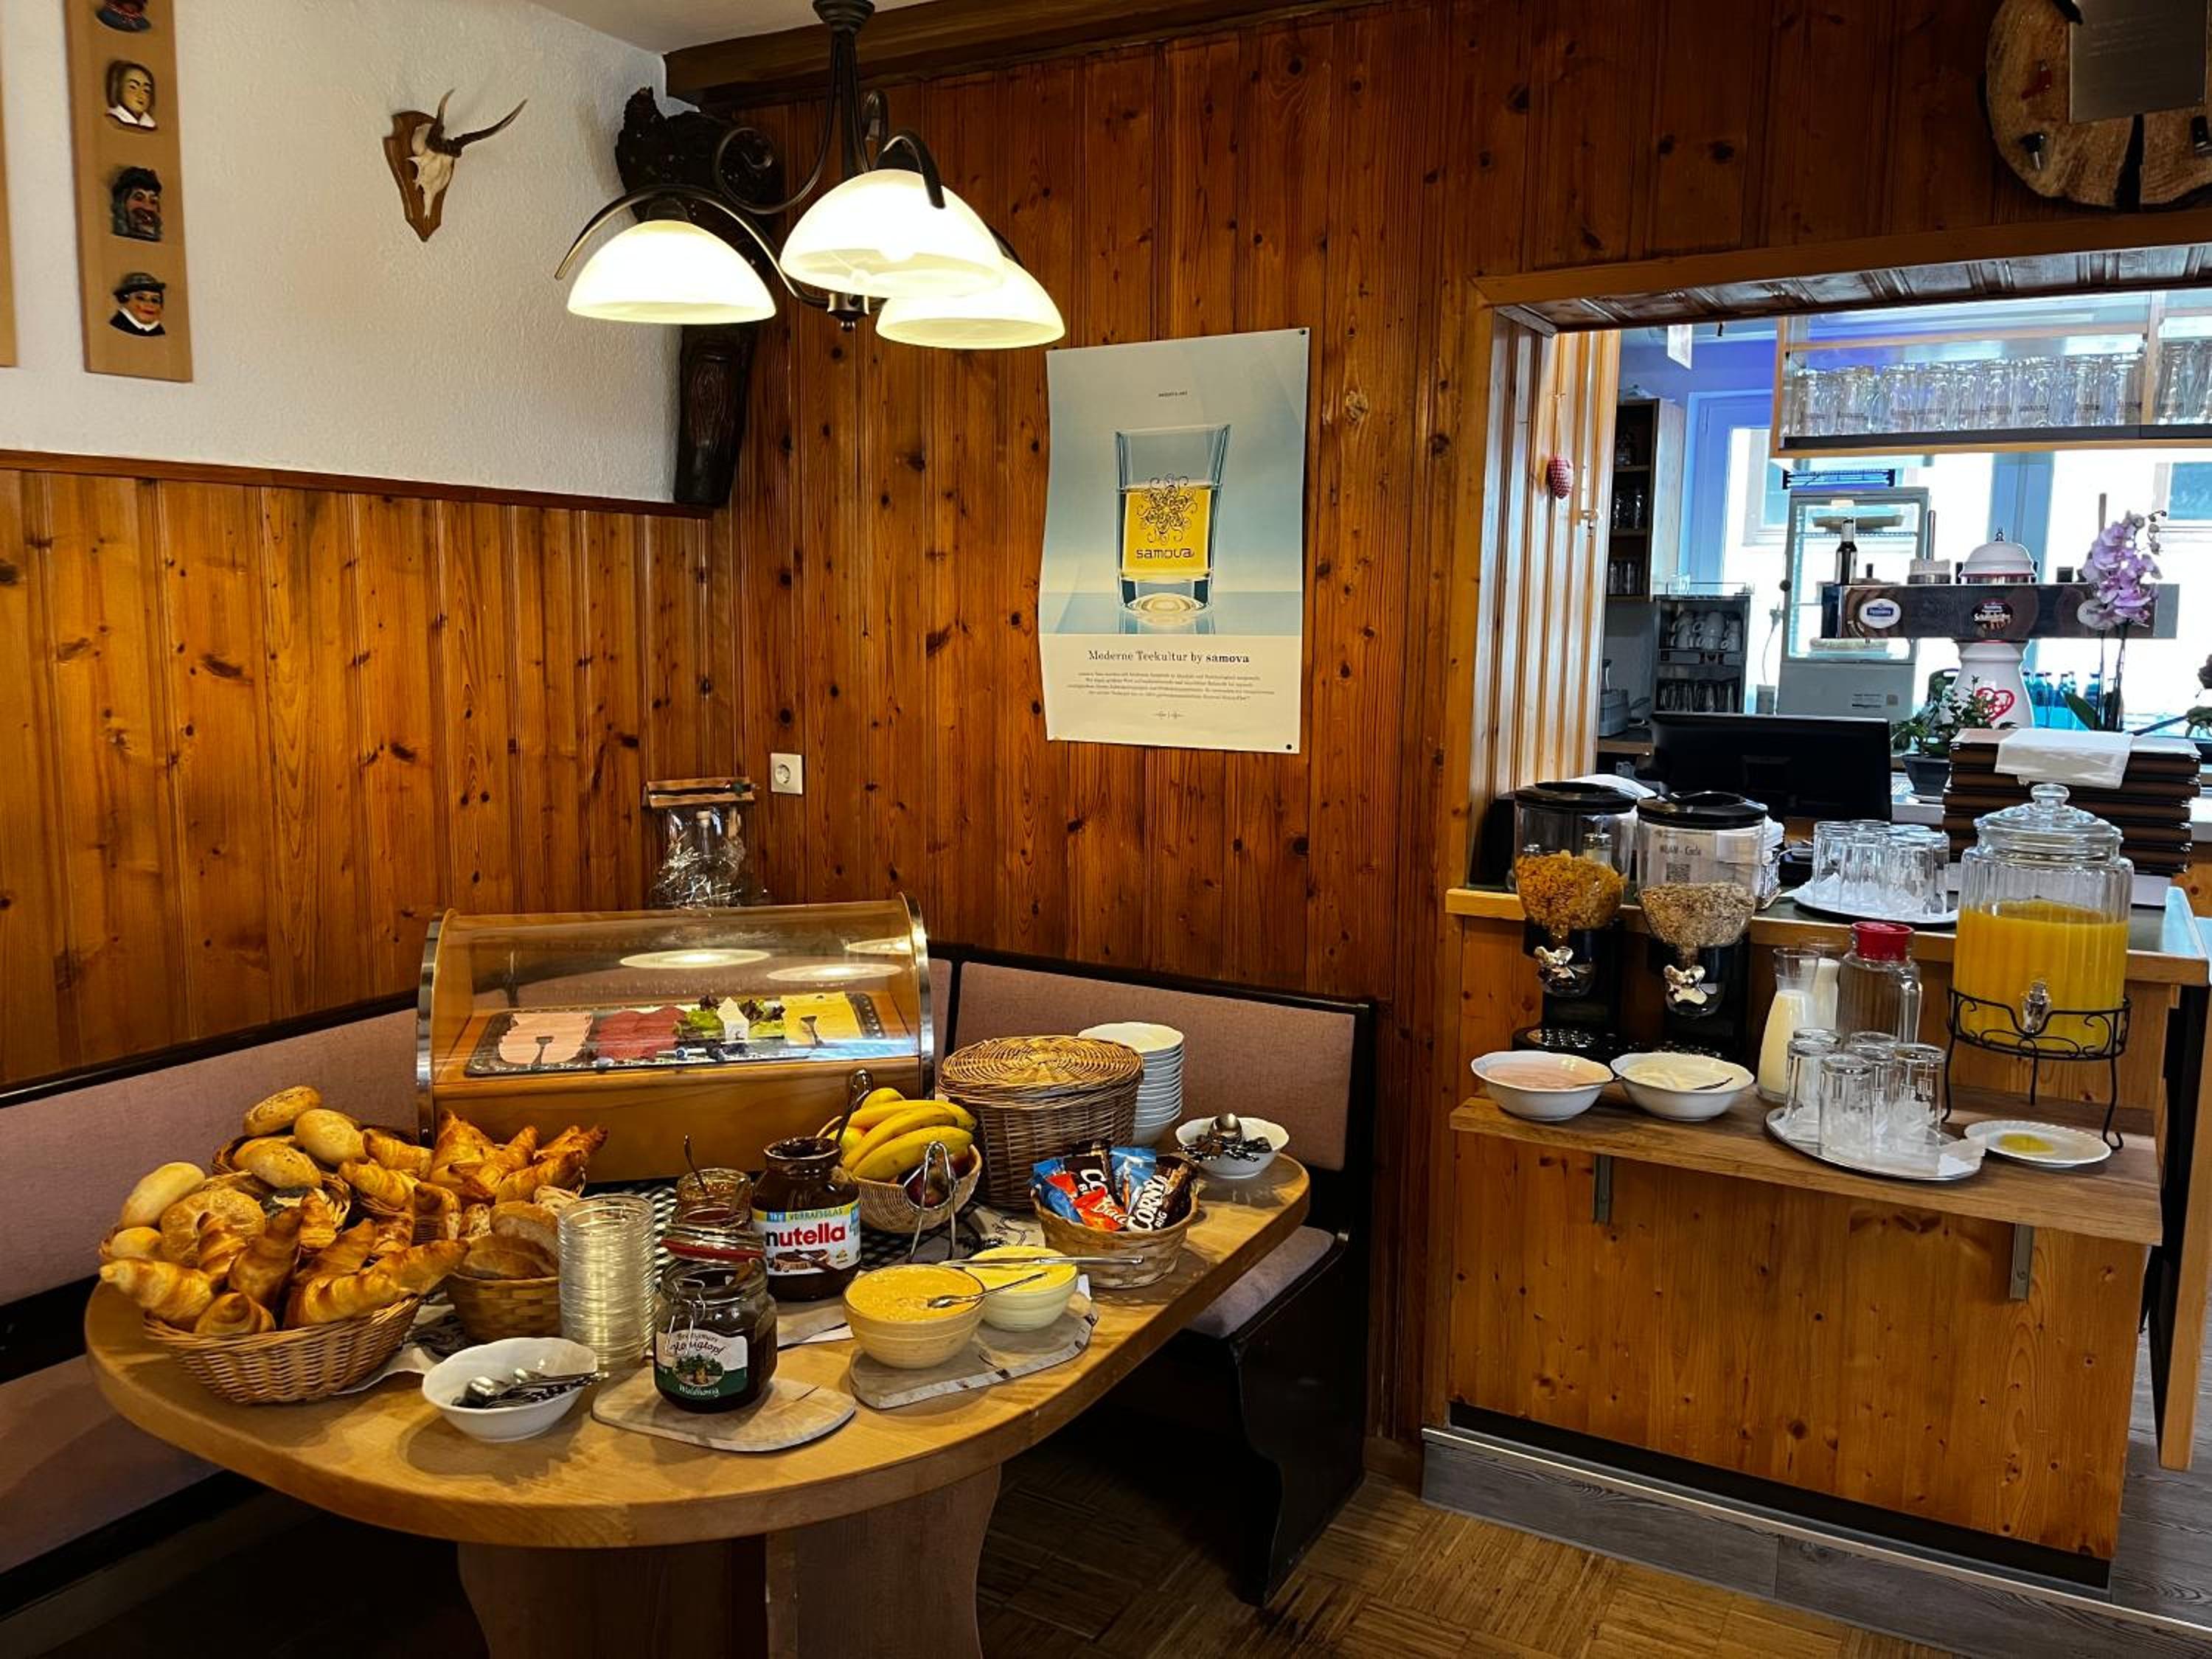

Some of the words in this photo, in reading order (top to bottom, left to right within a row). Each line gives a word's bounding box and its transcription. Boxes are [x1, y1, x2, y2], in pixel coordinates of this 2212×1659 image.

[1135, 547, 1194, 559] samova
[1088, 650, 1133, 661] Moderne
[1135, 650, 1188, 661] Teekultur
[1191, 652, 1203, 664] by
[1205, 653, 1251, 663] samova
[1127, 1178, 1165, 1231] CORNY
[1154, 1211, 1168, 1228] BIG
[765, 1222, 845, 1246] nutella
